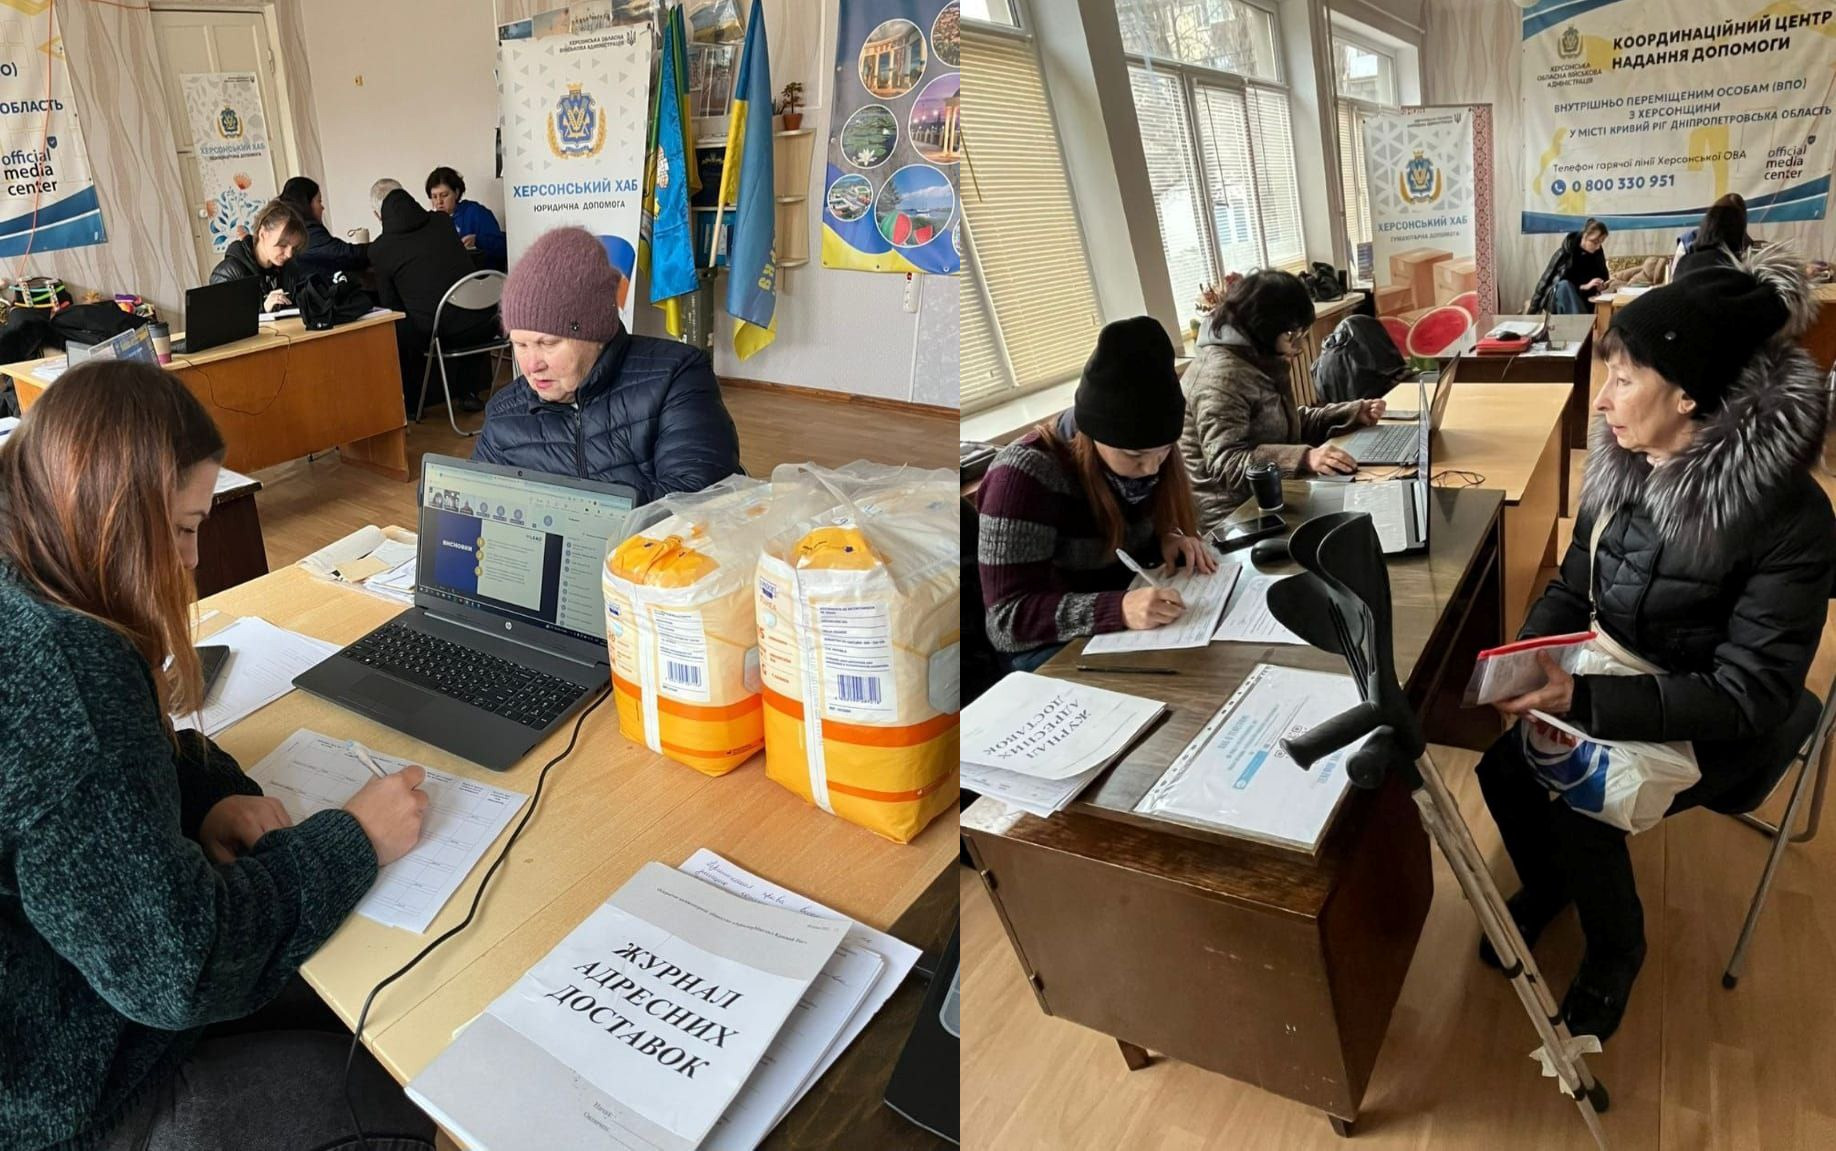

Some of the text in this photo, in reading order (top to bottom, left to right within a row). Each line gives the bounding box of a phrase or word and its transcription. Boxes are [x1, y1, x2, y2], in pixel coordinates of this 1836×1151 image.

[1613, 11, 1833, 51] КООРДИНАЦІЙНИЙ ЦЕНТР
[1611, 37, 1791, 70] НАДАННЯ ДОПОМОГИ
[1554, 78, 1807, 113] ВНУТРІШНЬО ПЕРЕМІЩЕНИМ ОСОБАМ (ВПО)
[0, 99, 64, 114] ОБЛАСТЬ
[1629, 102, 1721, 120] З ХЕРСОНЩИНИ
[1569, 106, 1832, 138] У МІСТІ КРИВИЙ РІГ ДНІПРОПЕТРОВСЬКА ОБЛАСТЬ
[2, 147, 52, 166] official
[1553, 150, 1747, 173] Телефон гарячої лінії Херсонської ОВА
[1768, 145, 1807, 158] official
[4, 162, 54, 181] media
[1765, 156, 1804, 169] media
[1572, 174, 1676, 193] 0 800 330 951
[1763, 169, 1803, 181] center
[8, 180, 58, 197] center
[513, 177, 638, 198] ХЕРСОНСЬКИЙ ХАБ
[534, 200, 625, 213] ЮРИДИЧНА ДОПОМОГА
[1377, 215, 1468, 233] ХЕРСОНСЬКИЙ ХАБ
[983, 695, 1064, 756] ДОСТАВОК
[998, 699, 1079, 760] АДРЕСНИХ
[1025, 709, 1092, 759] ЖУРНАЛ
[612, 942, 744, 1010] ЖУРНАЛ
[573, 961, 740, 1049] АДРЕСНИХ
[544, 984, 711, 1080] ДОСТАВОК
